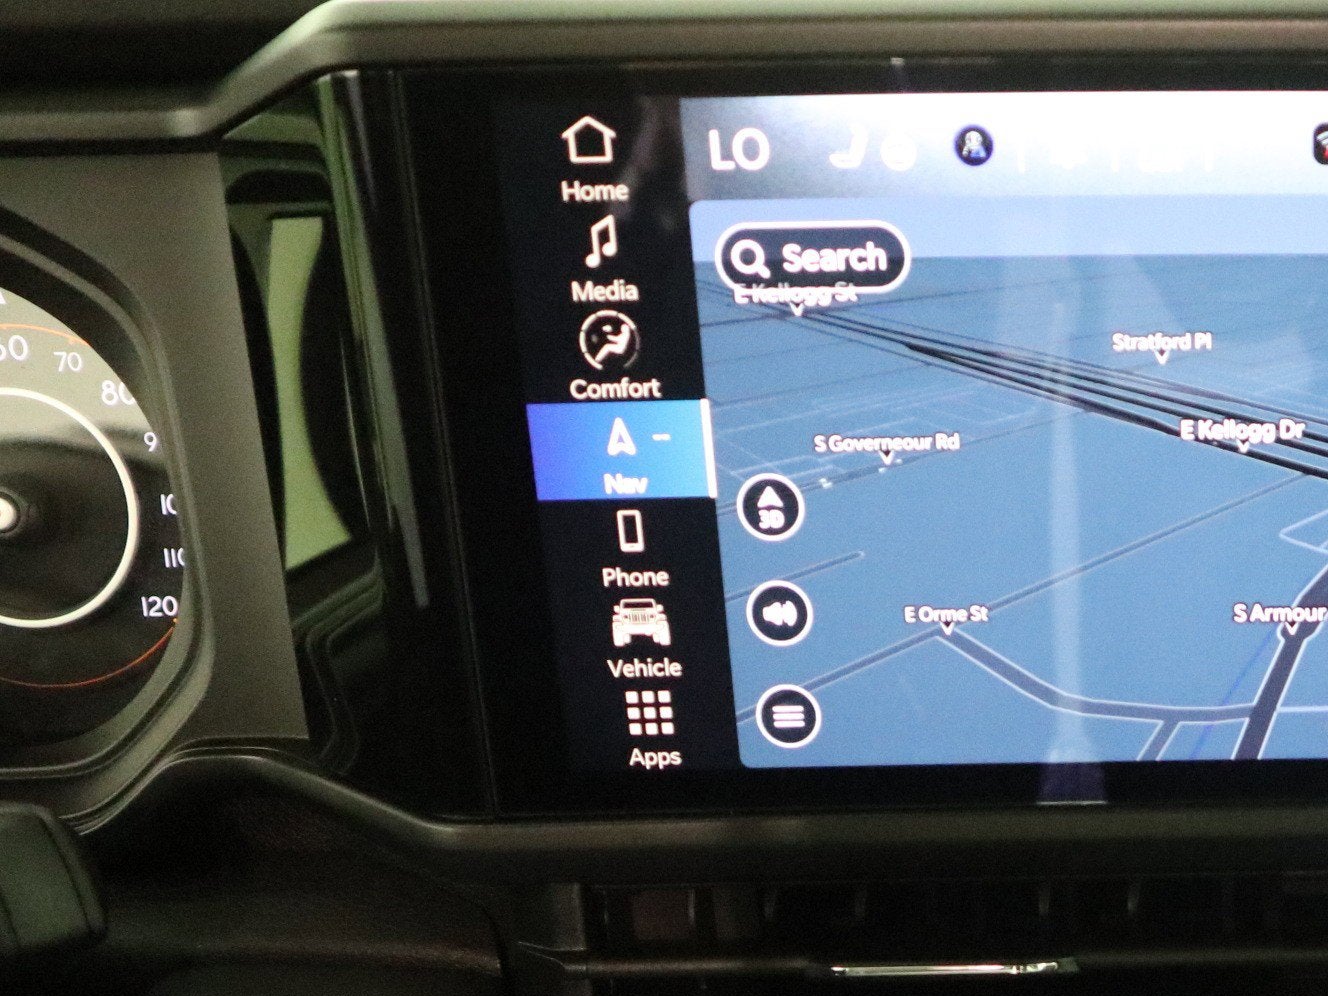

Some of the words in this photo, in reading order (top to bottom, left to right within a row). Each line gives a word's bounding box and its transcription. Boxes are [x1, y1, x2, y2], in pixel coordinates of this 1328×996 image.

[709, 127, 770, 171] LO
[561, 181, 628, 201] Home
[782, 241, 887, 273] Search
[571, 281, 638, 301] Media
[0, 334, 28, 362] 0
[1112, 332, 1190, 351] Stratford
[53, 351, 82, 372] 70
[570, 379, 661, 400] Comfort
[813, 435, 827, 452] S
[828, 434, 932, 452] Governeour
[935, 432, 961, 450] Rd
[1180, 420, 1195, 440] E
[1198, 419, 1276, 445] Kellogg
[1279, 419, 1306, 440] Dr
[604, 473, 647, 495] Nav
[759, 510, 785, 530] 3D
[602, 567, 670, 588] Phone
[141, 595, 179, 617] 120
[904, 606, 916, 624] E
[918, 607, 967, 624] Orme
[970, 605, 989, 622] St
[1233, 604, 1249, 623] S
[1250, 604, 1326, 624] Armour
[607, 658, 683, 678] Vehicle
[629, 747, 682, 769] Apps
